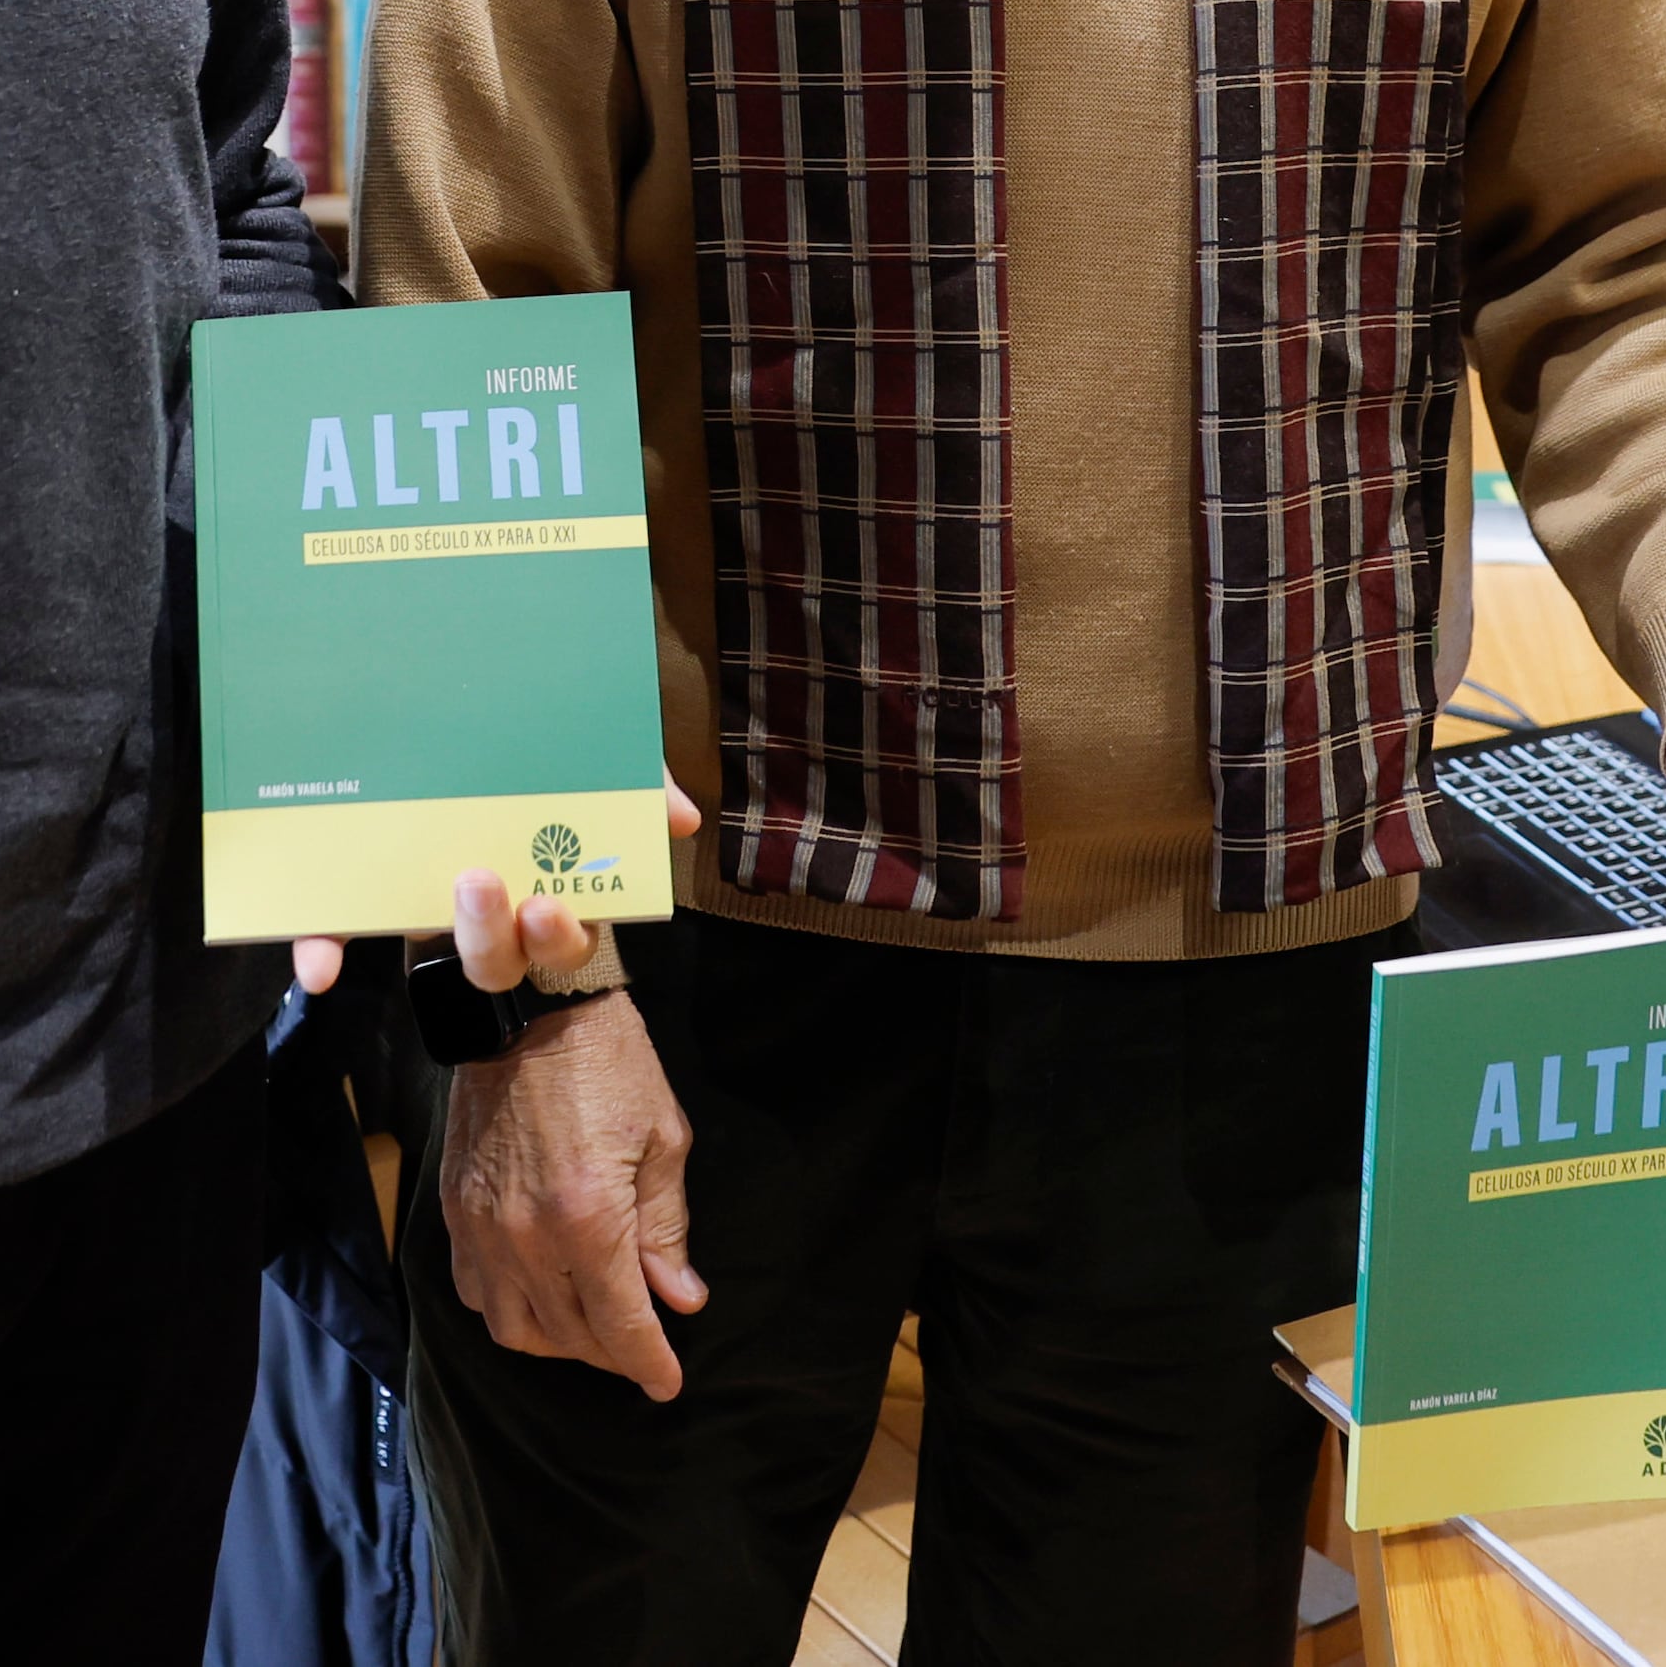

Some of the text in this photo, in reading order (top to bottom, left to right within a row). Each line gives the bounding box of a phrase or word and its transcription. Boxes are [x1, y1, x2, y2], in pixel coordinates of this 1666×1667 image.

[486, 364, 578, 395] INFORME
[301, 403, 583, 510] ALTRI
[311, 524, 577, 557] CELULOSA DO SÉCULO XX PARA O XXI
[297, 781, 335, 797] VARELA
[336, 779, 361, 795] DÍAZ
[533, 875, 624, 895] ADEGA
[1476, 1169, 1541, 1194] CELULOSA
[1545, 1165, 1563, 1184] DO
[1567, 1156, 1617, 1182] SÉCULO
[1621, 1157, 1638, 1175] XX
[1410, 1387, 1498, 1411] RAMÓN VARELA DÍAZ
